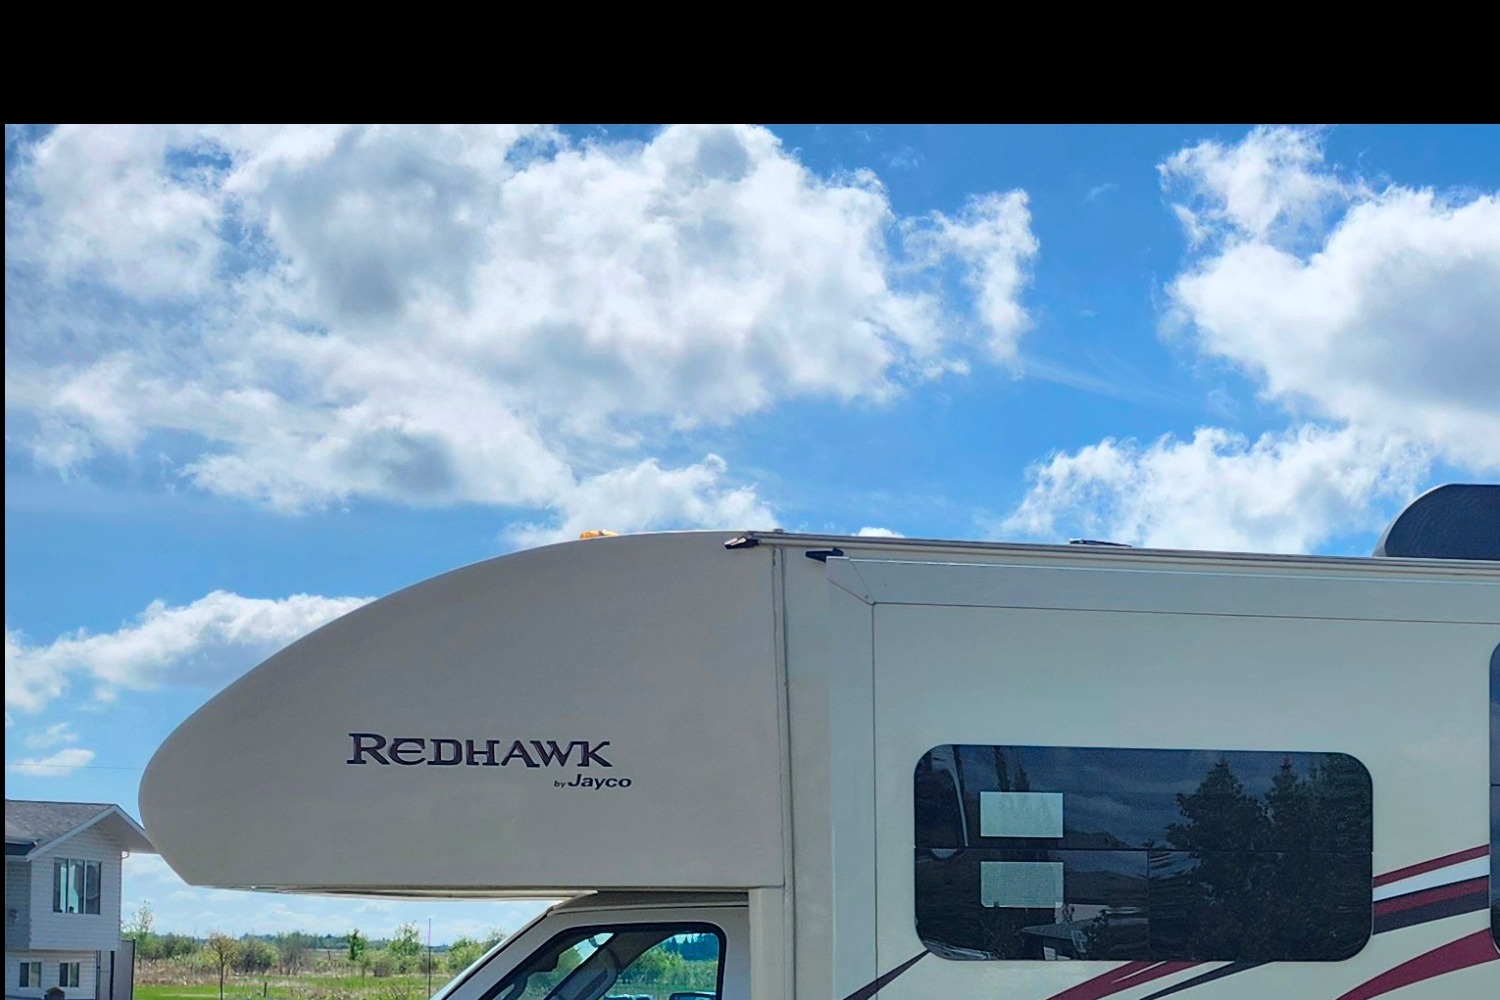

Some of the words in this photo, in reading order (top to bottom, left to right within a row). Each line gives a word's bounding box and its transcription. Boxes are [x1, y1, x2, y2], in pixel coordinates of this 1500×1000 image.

[346, 732, 613, 768] REDHAWK
[553, 780, 566, 789] by
[568, 773, 632, 791] Jayco
